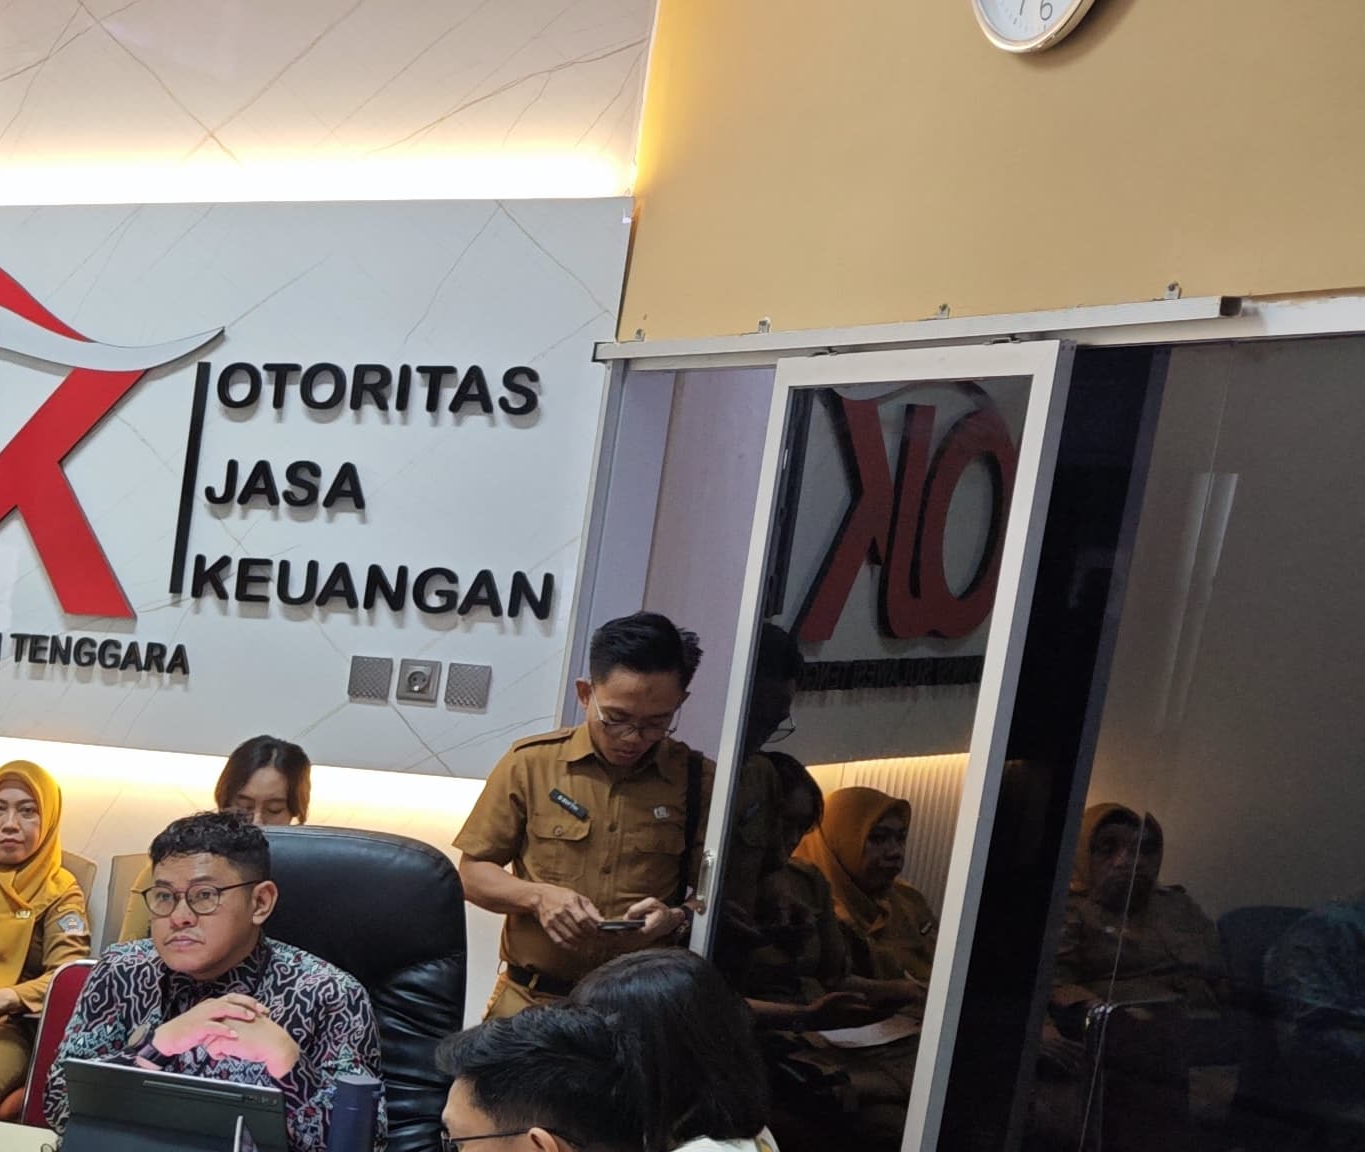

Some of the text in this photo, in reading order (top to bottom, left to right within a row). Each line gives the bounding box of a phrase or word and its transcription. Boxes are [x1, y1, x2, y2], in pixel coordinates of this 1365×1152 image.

[217, 361, 541, 415] OTORITAS
[204, 459, 366, 510] JASA
[190, 554, 555, 620] KEUANGAN
[10, 632, 190, 676] TENGGARA
